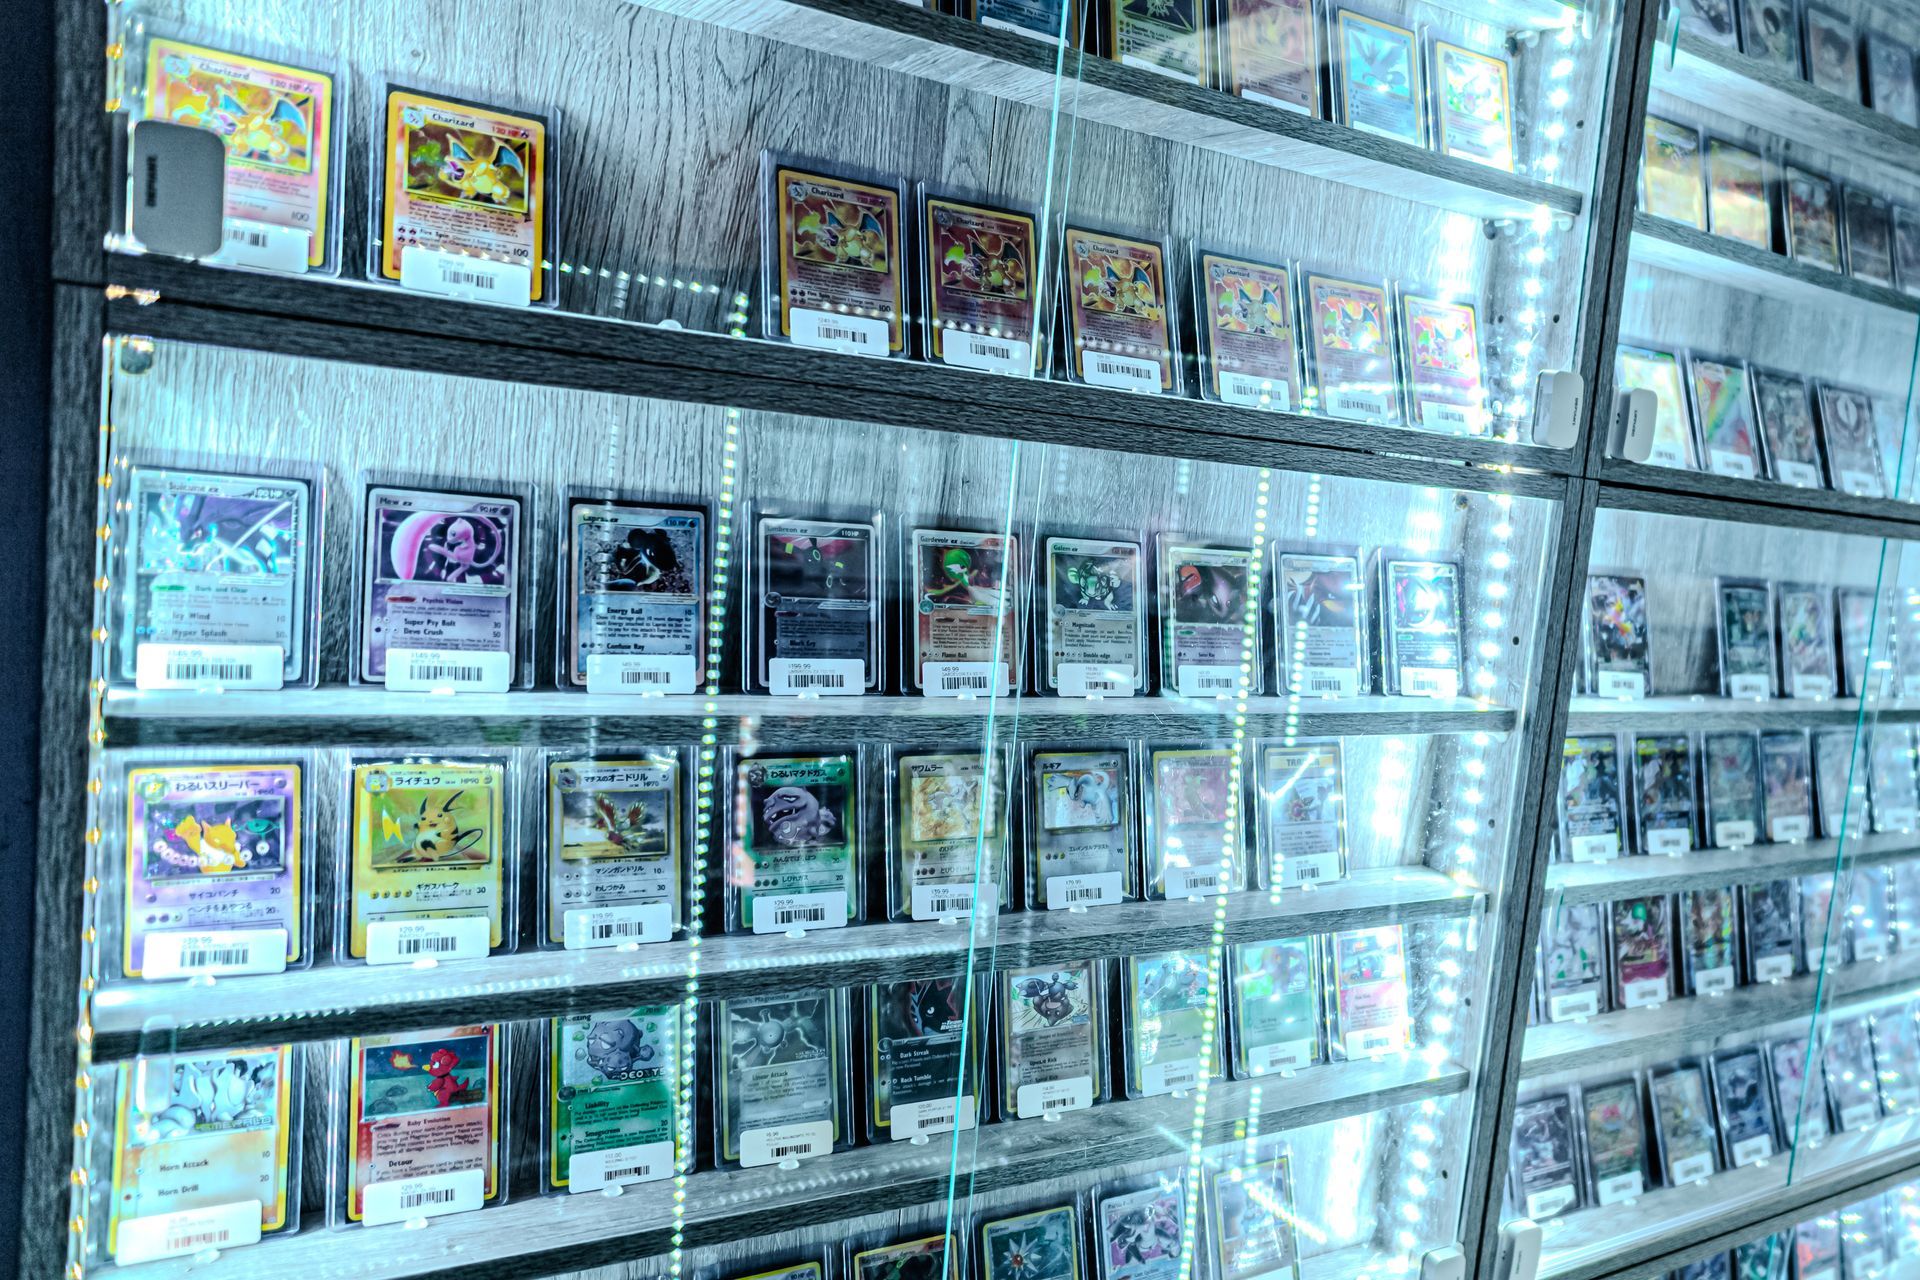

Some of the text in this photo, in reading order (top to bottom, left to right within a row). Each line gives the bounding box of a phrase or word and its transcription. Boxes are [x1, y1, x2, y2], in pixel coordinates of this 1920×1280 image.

[200, 62, 250, 80] Charizard
[432, 113, 475, 129] Charizard
[491, 125, 506, 136] 120
[811, 186, 844, 199] Charizard
[291, 211, 310, 222] 100
[956, 216, 985, 228] Charizard
[513, 248, 529, 258] 100
[1092, 244, 1118, 255] Charizard
[1226, 268, 1250, 278] Charizard
[879, 304, 892, 313] 100
[380, 496, 399, 505] Mew
[920, 535, 948, 544] Gardevoir
[607, 607, 628, 616] Energy
[189, 613, 210, 621] Wind
[404, 618, 456, 629] Super Psy Bolt
[1072, 622, 1095, 630] Magnitude
[172, 628, 227, 639] Hyper Splash
[423, 628, 444, 636] Crush
[607, 642, 645, 651] Confuse Ray
[911, 765, 944, 773] サワムラー
[584, 774, 648, 783] マチスのオニドリル
[770, 769, 828, 779] わるいマタドガス
[395, 777, 441, 786] ライチュウ
[460, 777, 479, 785] HP90
[176, 781, 260, 792] わるいスリーパー
[595, 866, 645, 875] マシンガンドリル
[416, 882, 459, 890] ギガスパーク
[188, 889, 239, 899] サイコパンチ
[270, 887, 280, 895] 20
[900, 1051, 912, 1059] Dark
[914, 1074, 932, 1082] Tumble
[585, 1101, 610, 1110] Liability
[423, 1116, 451, 1125] Evolution
[585, 1127, 621, 1138] Smogscreen
[261, 1150, 270, 1158] 10
[159, 1159, 209, 1172] Horn Attack
[388, 1159, 414, 1167] Detour
[260, 1174, 270, 1182] 20
[158, 1185, 199, 1197] Horn Drill
